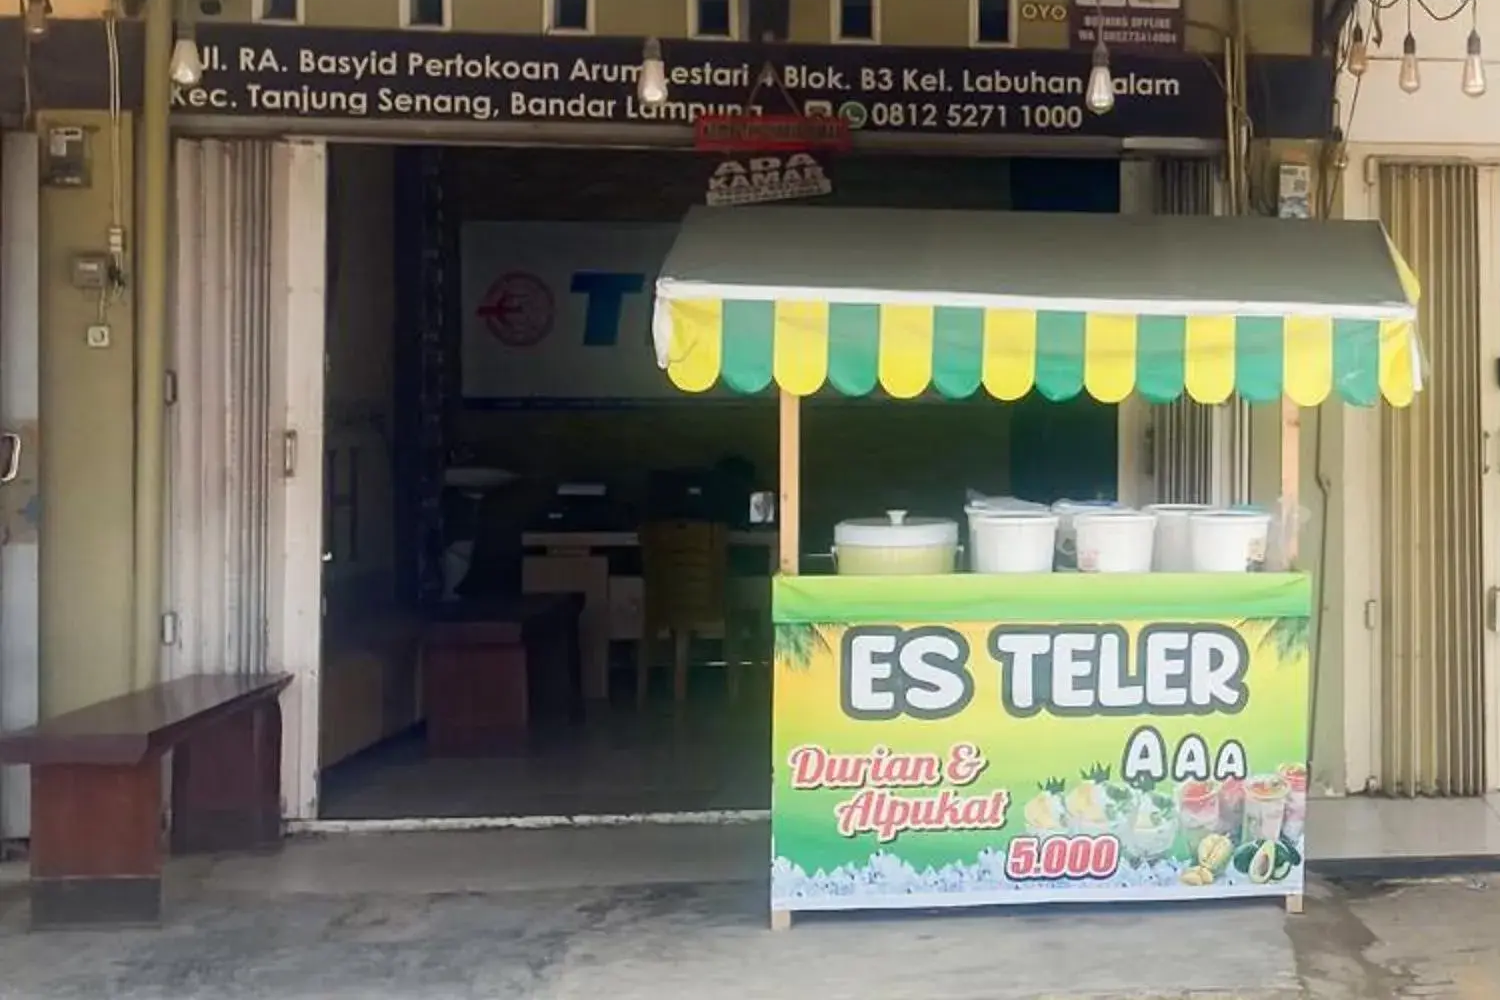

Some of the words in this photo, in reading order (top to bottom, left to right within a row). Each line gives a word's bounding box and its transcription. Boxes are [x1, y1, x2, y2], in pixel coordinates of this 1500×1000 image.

[1021, 3, 1067, 20] OYO
[239, 48, 288, 73] RA.
[299, 50, 397, 80] Basyid
[408, 53, 559, 80] Pertokoan
[570, 58, 644, 82] Arum
[663, 62, 749, 87] estari
[784, 65, 850, 90] Blok.
[861, 67, 893, 92] B3
[903, 68, 952, 92] Kel.
[963, 69, 1082, 94] Labuhan
[1111, 72, 1180, 96] alam
[247, 84, 367, 114] Tanjung
[378, 87, 499, 120] Senang,
[511, 92, 616, 118] Bandar
[872, 103, 938, 127] 0812
[946, 104, 1007, 128] 5271
[1022, 104, 1083, 129] 1000
[848, 631, 967, 713] ES
[994, 629, 1244, 712] TELER
[790, 746, 940, 787] Durian
[949, 744, 988, 783] &
[836, 789, 1012, 840] Alpukat
[1005, 835, 1119, 881] 5.000
